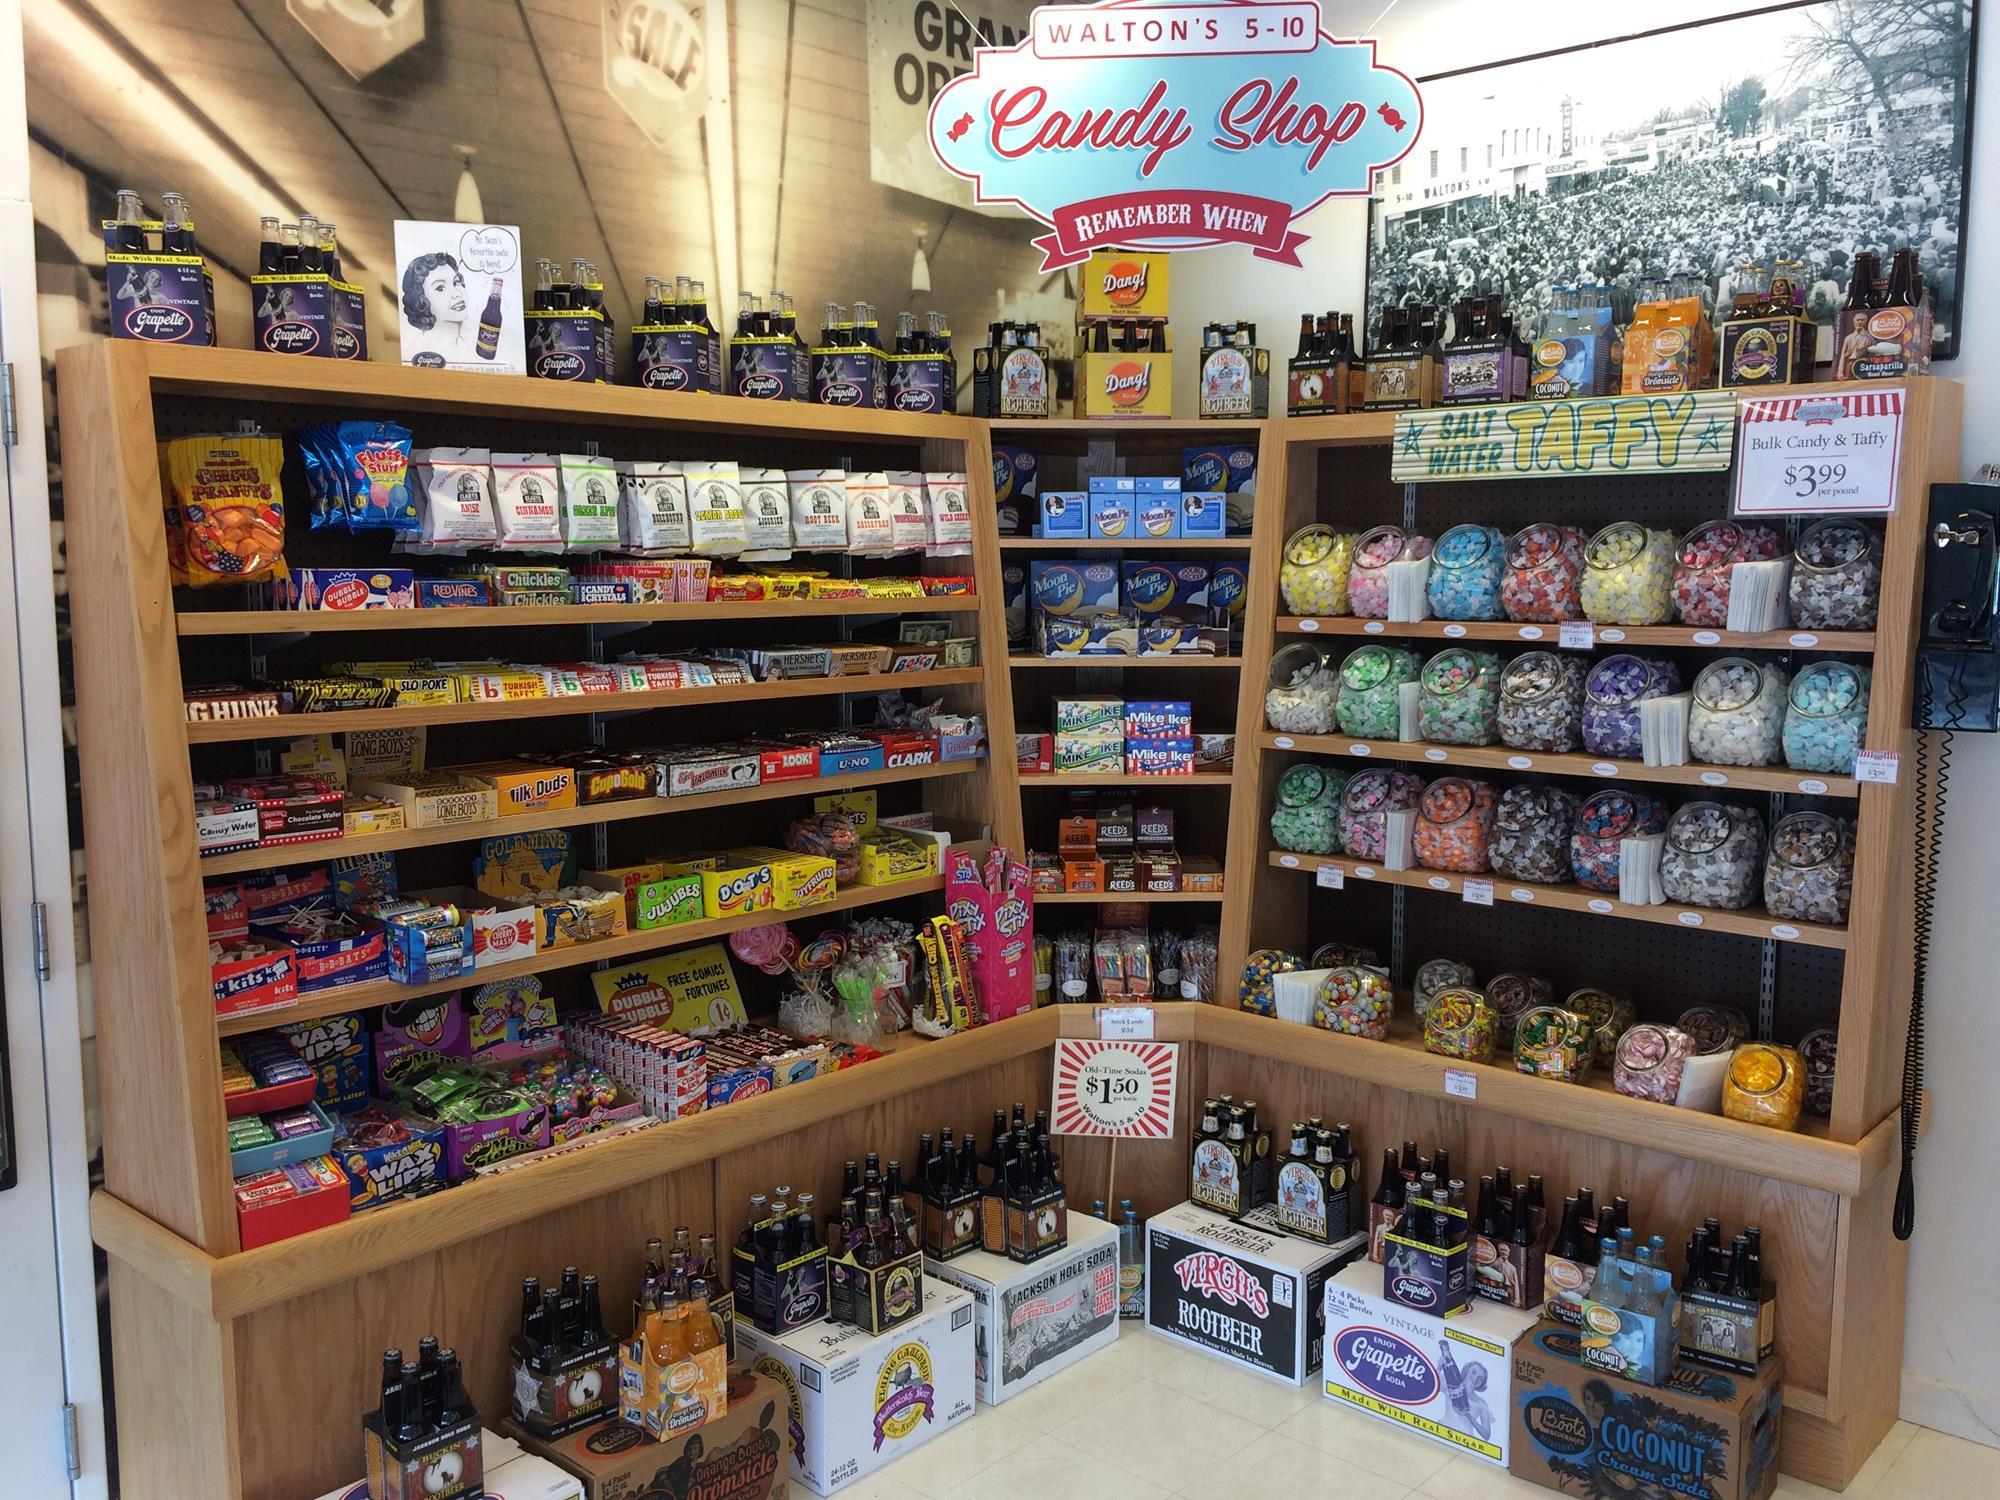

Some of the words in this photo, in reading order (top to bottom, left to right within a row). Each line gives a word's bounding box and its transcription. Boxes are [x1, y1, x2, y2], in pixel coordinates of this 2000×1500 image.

[1048, 17, 1219, 45] WALTON'S
[1245, 15, 1305, 40] 5-10
[991, 80, 1193, 176] Candy
[1215, 76, 1367, 171] Shop
[1424, 180, 1470, 200] WALTON'S
[1075, 202, 1191, 243] REMEMBER
[1202, 203, 1268, 235] WHEN
[1104, 262, 1148, 294] Dang!
[134, 311, 185, 333] Grapette
[273, 329, 313, 348] Grapette
[543, 358, 579, 376] Grapette
[1860, 362, 1903, 372] Sarsaparilla
[650, 370, 684, 388] Grapette
[1106, 362, 1150, 393] Dang!
[747, 379, 777, 396] Grapette
[828, 388, 857, 404] Grapette
[1535, 382, 1564, 394] COCONUT
[901, 394, 930, 409] Grapette
[1439, 410, 1497, 441] SALT
[1505, 393, 1696, 474] TAFFY
[1752, 437, 1782, 450] Bulk
[1787, 434, 1831, 451] Candy
[1835, 434, 1847, 446] &
[1852, 431, 1887, 447] Taffy
[368, 462, 398, 474] Stuff
[1427, 442, 1502, 476] WATER
[1185, 459, 1214, 481] Moon
[1205, 469, 1222, 486] Pie
[192, 484, 272, 500] PEANUTS
[1833, 486, 1859, 496] pound
[460, 504, 480, 513] ANISE
[516, 505, 554, 515] CINNAMON
[695, 510, 724, 521] LEMON
[805, 516, 822, 525] ROOT
[824, 516, 839, 524] BEER
[328, 583, 356, 601] DUBBLE
[586, 585, 615, 594] CANDY
[1034, 573, 1068, 595] Moon
[1057, 582, 1076, 597] Pie
[1127, 572, 1161, 592] Moon
[1150, 581, 1168, 596] Pie
[1208, 573, 1235, 593] Moon
[1225, 582, 1241, 599] Pie
[336, 589, 366, 609] BUBBLE
[586, 593, 626, 602] CRYSTALS
[648, 672, 677, 680] TURKISH
[650, 680, 676, 688] TAFFY
[320, 689, 355, 700] BLACK
[357, 689, 383, 699] COW
[401, 680, 418, 691] SLO
[503, 682, 538, 690] TURKISH
[507, 690, 535, 698] TAFFY
[185, 703, 209, 721] IG
[211, 701, 279, 720] HUNK
[1062, 714, 1091, 727] MIKE
[1101, 706, 1120, 716] IKE
[1129, 712, 1165, 723] Mike
[1169, 714, 1189, 725] Ike
[350, 740, 378, 757] LONG
[379, 737, 404, 755] BOYS
[1062, 750, 1091, 763] MIKE
[1101, 742, 1120, 752] IKE
[1132, 750, 1167, 760] Mike
[1171, 751, 1192, 761] Ike
[782, 754, 813, 767] LOOK!
[839, 758, 870, 769] U-NO
[888, 751, 933, 768] CLARK
[536, 773, 568, 798] Duds
[288, 814, 322, 824] Chocolate
[323, 811, 342, 819] Wafer
[436, 804, 457, 818] LONG
[458, 801, 477, 815] BOYS
[232, 821, 257, 831] Wafer
[1101, 826, 1128, 837] REED'S
[1141, 824, 1168, 835] REED'S
[1110, 880, 1135, 891] REED'S
[1148, 880, 1174, 891] REED'S
[646, 884, 700, 920] JUJUBES
[228, 970, 263, 992] kits
[667, 972, 691, 987] FREE
[693, 963, 725, 980] COMICS
[274, 984, 294, 994] kits
[685, 979, 730, 1000] FORTUNES
[612, 987, 666, 1012] DUBBLE
[1085, 1066, 1123, 1075] Old-Time
[1125, 1067, 1147, 1075] Sodas
[1082, 1103, 1118, 1126] Walton's
[1134, 1106, 1145, 1117] 10
[369, 1144, 436, 1180] WAX
[376, 1159, 436, 1196] LIPS
[1010, 1274, 1057, 1307] JACKSON
[1060, 1261, 1084, 1282] HOLE
[1087, 1248, 1112, 1268] SODA
[1174, 1252, 1269, 1318] VIRGIL'S
[1347, 1293, 1364, 1304] Packs
[1398, 1280, 1432, 1301] Grapette
[1178, 1298, 1263, 1356] ROOTBEER
[1383, 1314, 1434, 1338] VINTAGE
[1373, 1335, 1398, 1350] ENJOY
[1346, 1337, 1427, 1381] Grapette
[1586, 1347, 1620, 1365] COCONUT
[1526, 1362, 1545, 1374] Packs
[1385, 1375, 1406, 1388] SODA
[567, 1402, 603, 1419] ROOTBEER
[948, 1404, 972, 1422] NATURAL
[955, 1400, 965, 1409] ALL
[1541, 1409, 1586, 1439] Boots
[1602, 1416, 1705, 1478] COCONUT
[613, 1471, 631, 1484] Packs
[830, 1464, 846, 1477] 24-12
[831, 1467, 859, 1486] BOTTLES
[1598, 1451, 1658, 1483] Cream
[1662, 1472, 1712, 1500] Soda
